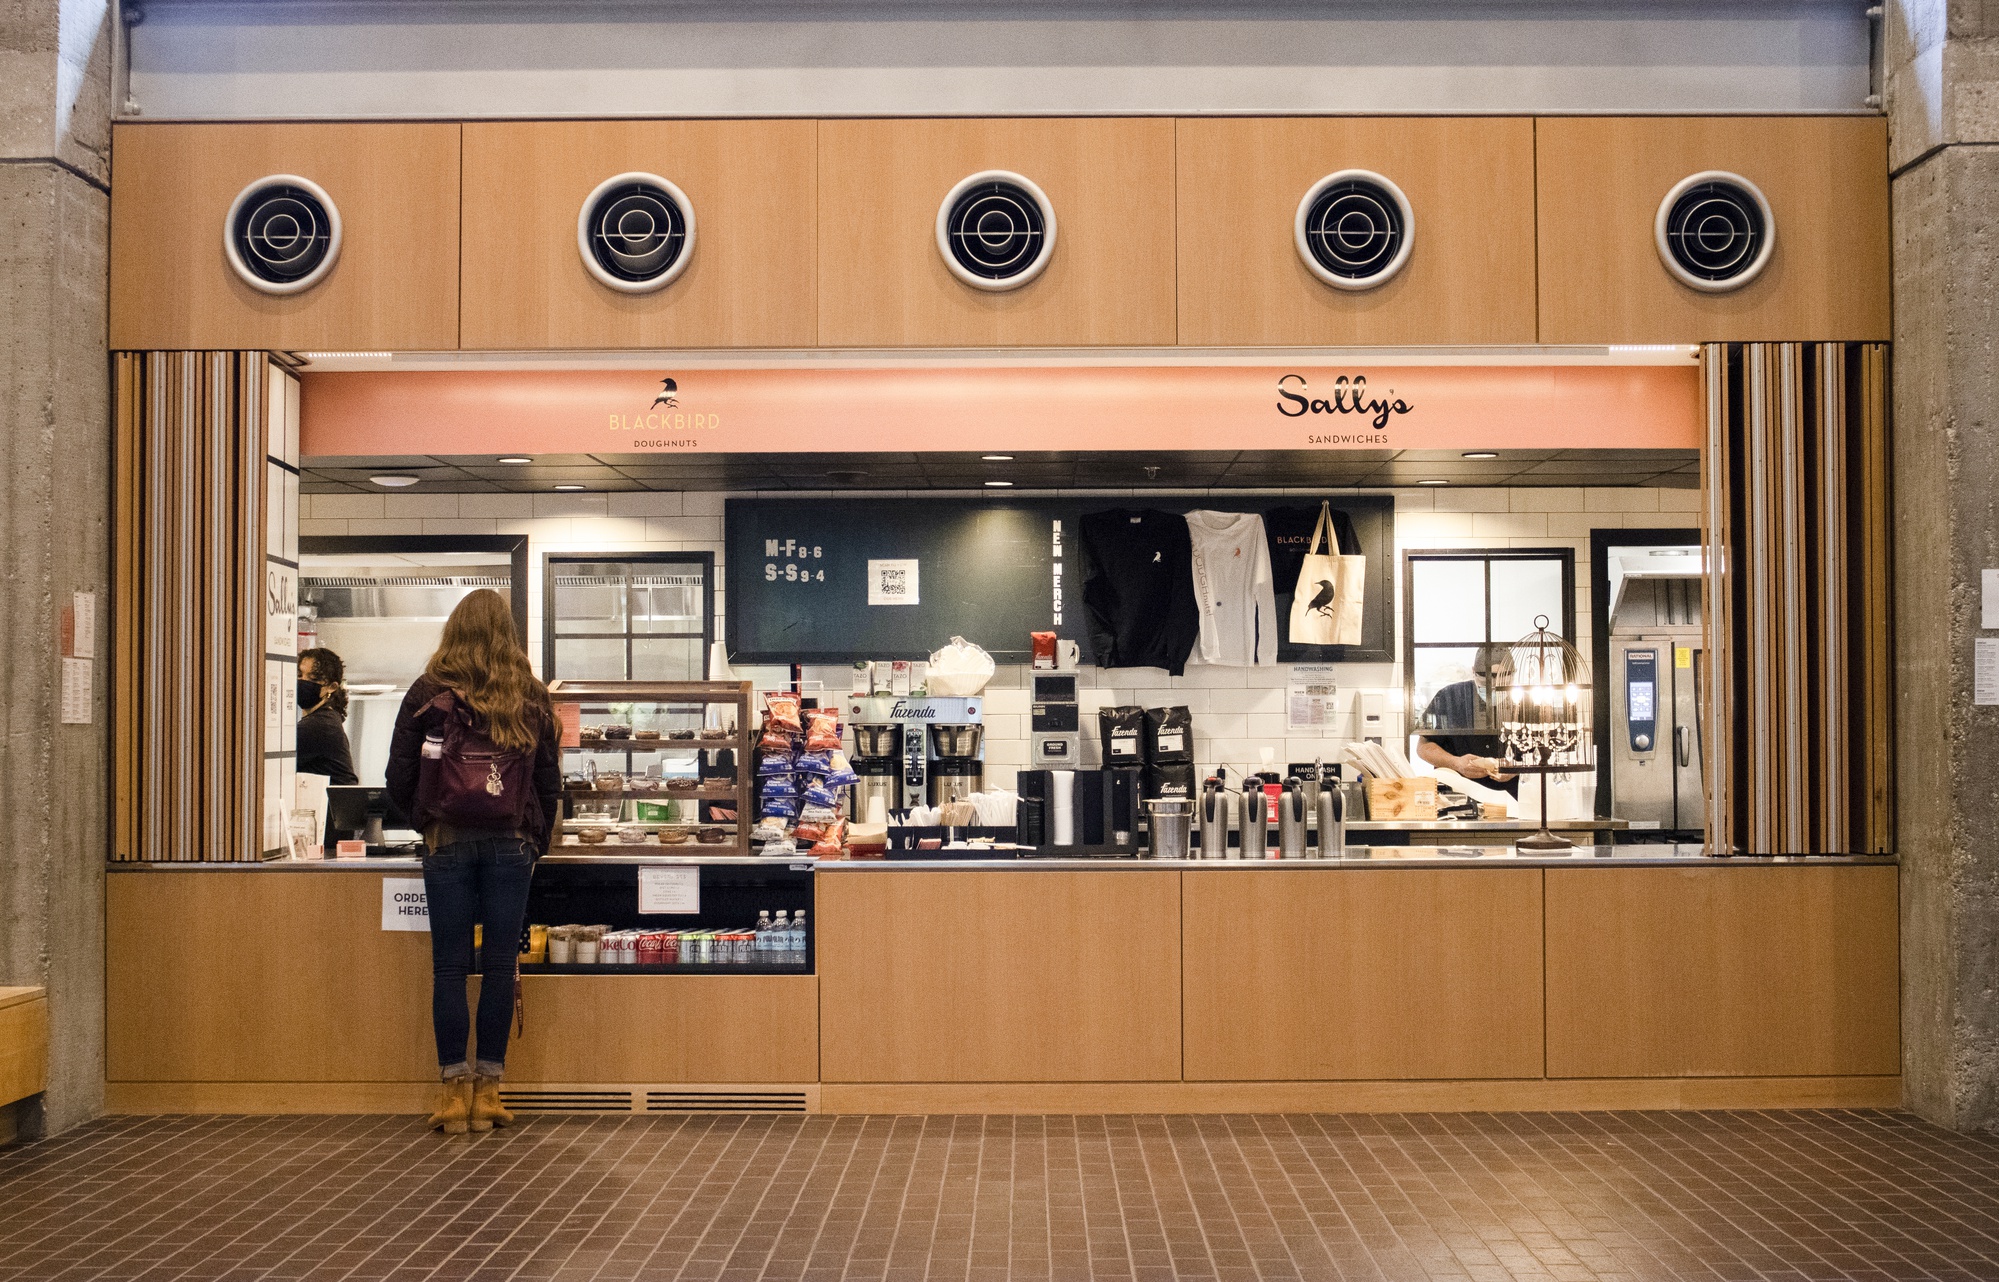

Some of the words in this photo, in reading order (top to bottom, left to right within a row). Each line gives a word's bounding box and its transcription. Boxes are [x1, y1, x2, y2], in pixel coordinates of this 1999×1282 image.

[1277, 374, 1414, 430] Sally's
[609, 413, 720, 430] BLACKBIRD
[1308, 435, 1388, 444] SANDWICHES
[1053, 520, 1062, 557] NEW
[1277, 536, 1327, 544] BLACKBD
[765, 539, 796, 557] M-F
[798, 546, 822, 558] 8-6
[765, 563, 798, 581] S-S
[800, 569, 825, 583] 9-4
[1053, 563, 1062, 625] MERCH
[890, 700, 936, 718] Fazenda
[1111, 725, 1138, 737] Fazenda
[1157, 724, 1184, 735] Fazenda
[1160, 782, 1187, 793] Fazenda
[394, 892, 427, 903] ORDE
[399, 906, 429, 916] HERE
